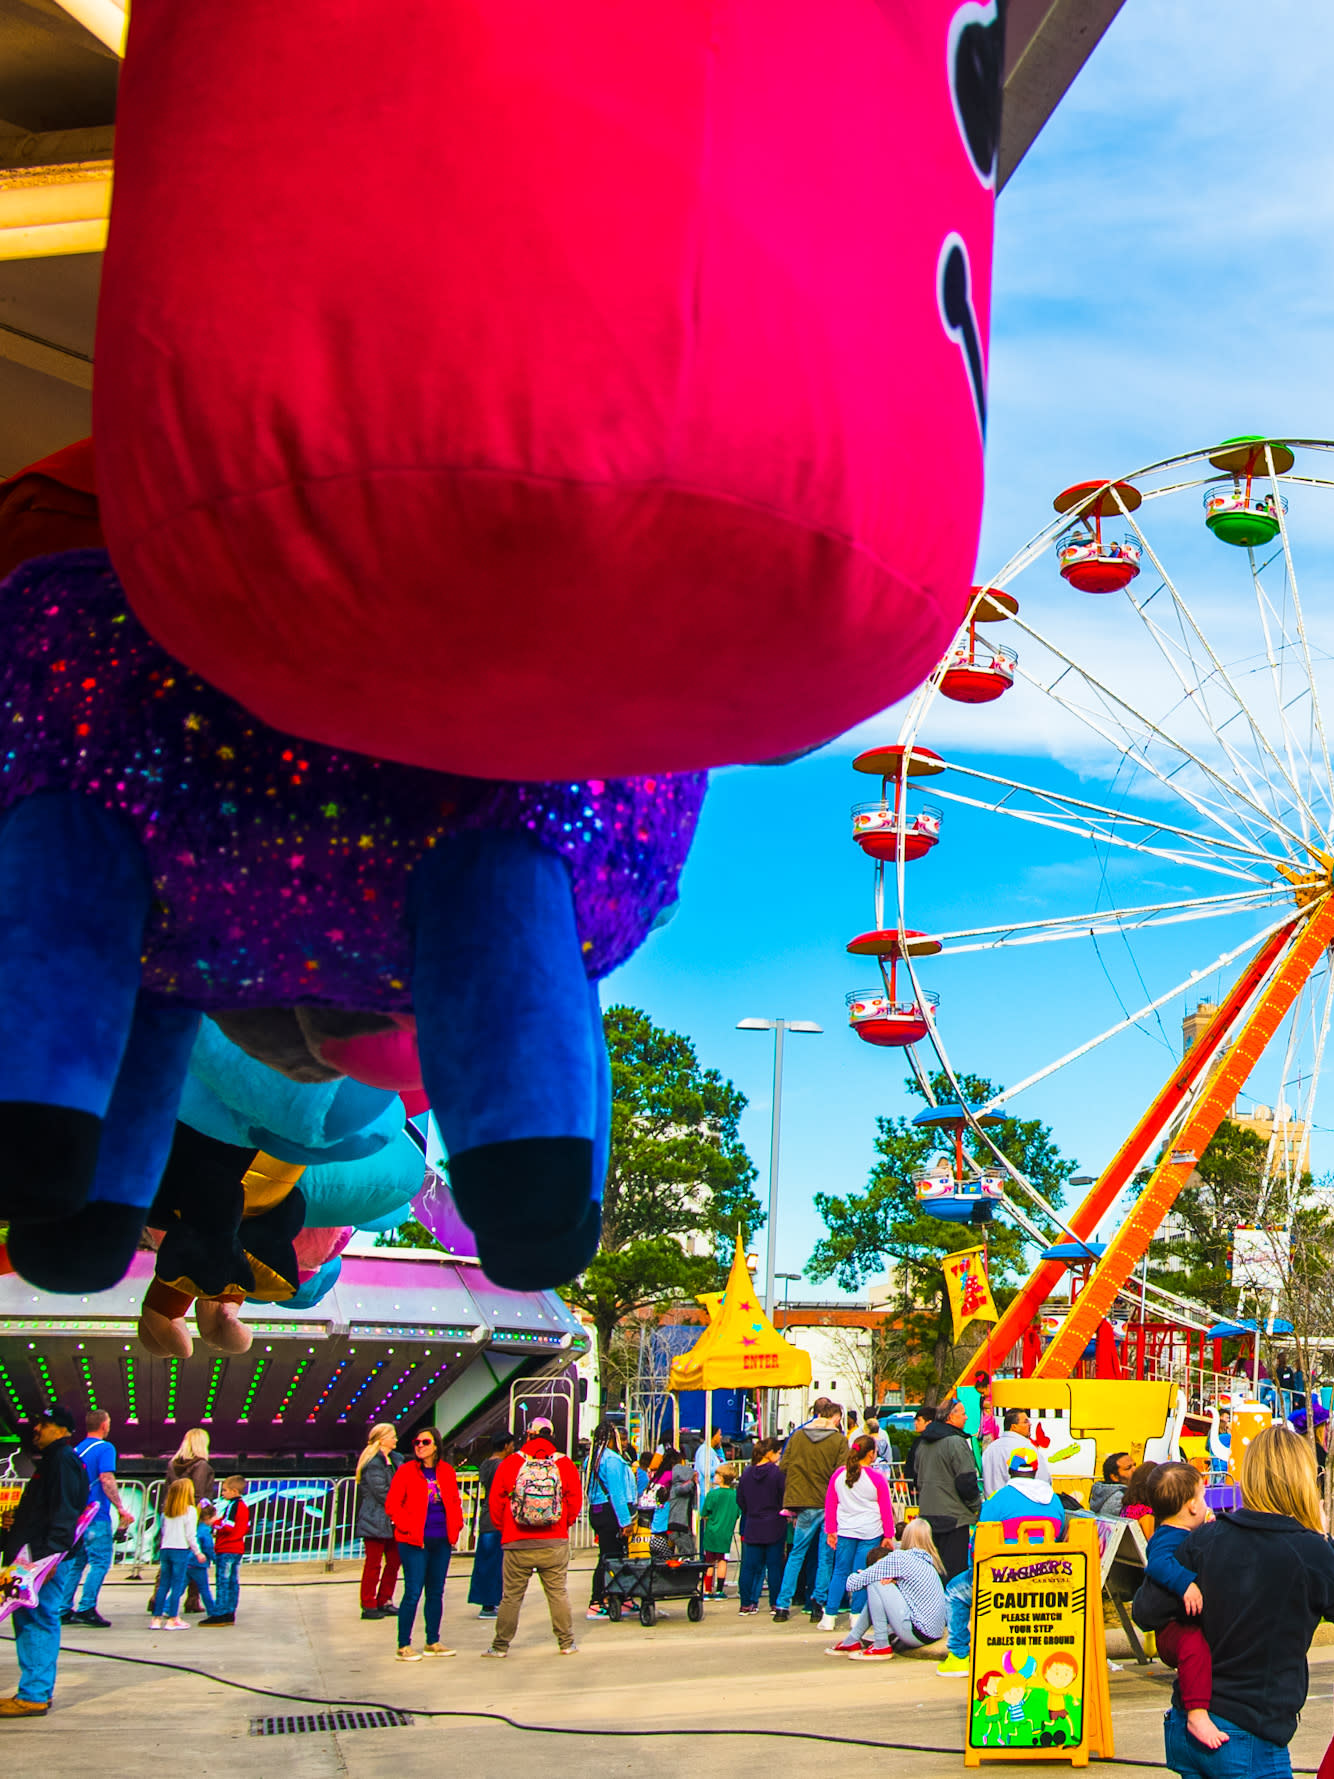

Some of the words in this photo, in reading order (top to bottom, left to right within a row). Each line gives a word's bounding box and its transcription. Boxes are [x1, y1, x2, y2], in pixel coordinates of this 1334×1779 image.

[743, 1354, 779, 1369] ENTER
[991, 1560, 1073, 1583] WAGNER'S
[993, 1592, 1069, 1608] CAUTION
[1001, 1613, 1030, 1622] PLEASE
[1032, 1612, 1062, 1621] WATCH
[1009, 1625, 1031, 1634] YOUR
[1033, 1624, 1054, 1633] STEP
[987, 1637, 1014, 1646] CABLES
[1016, 1636, 1026, 1645] ON
[1028, 1636, 1042, 1645] THE
[1043, 1635, 1075, 1645] GROUND
